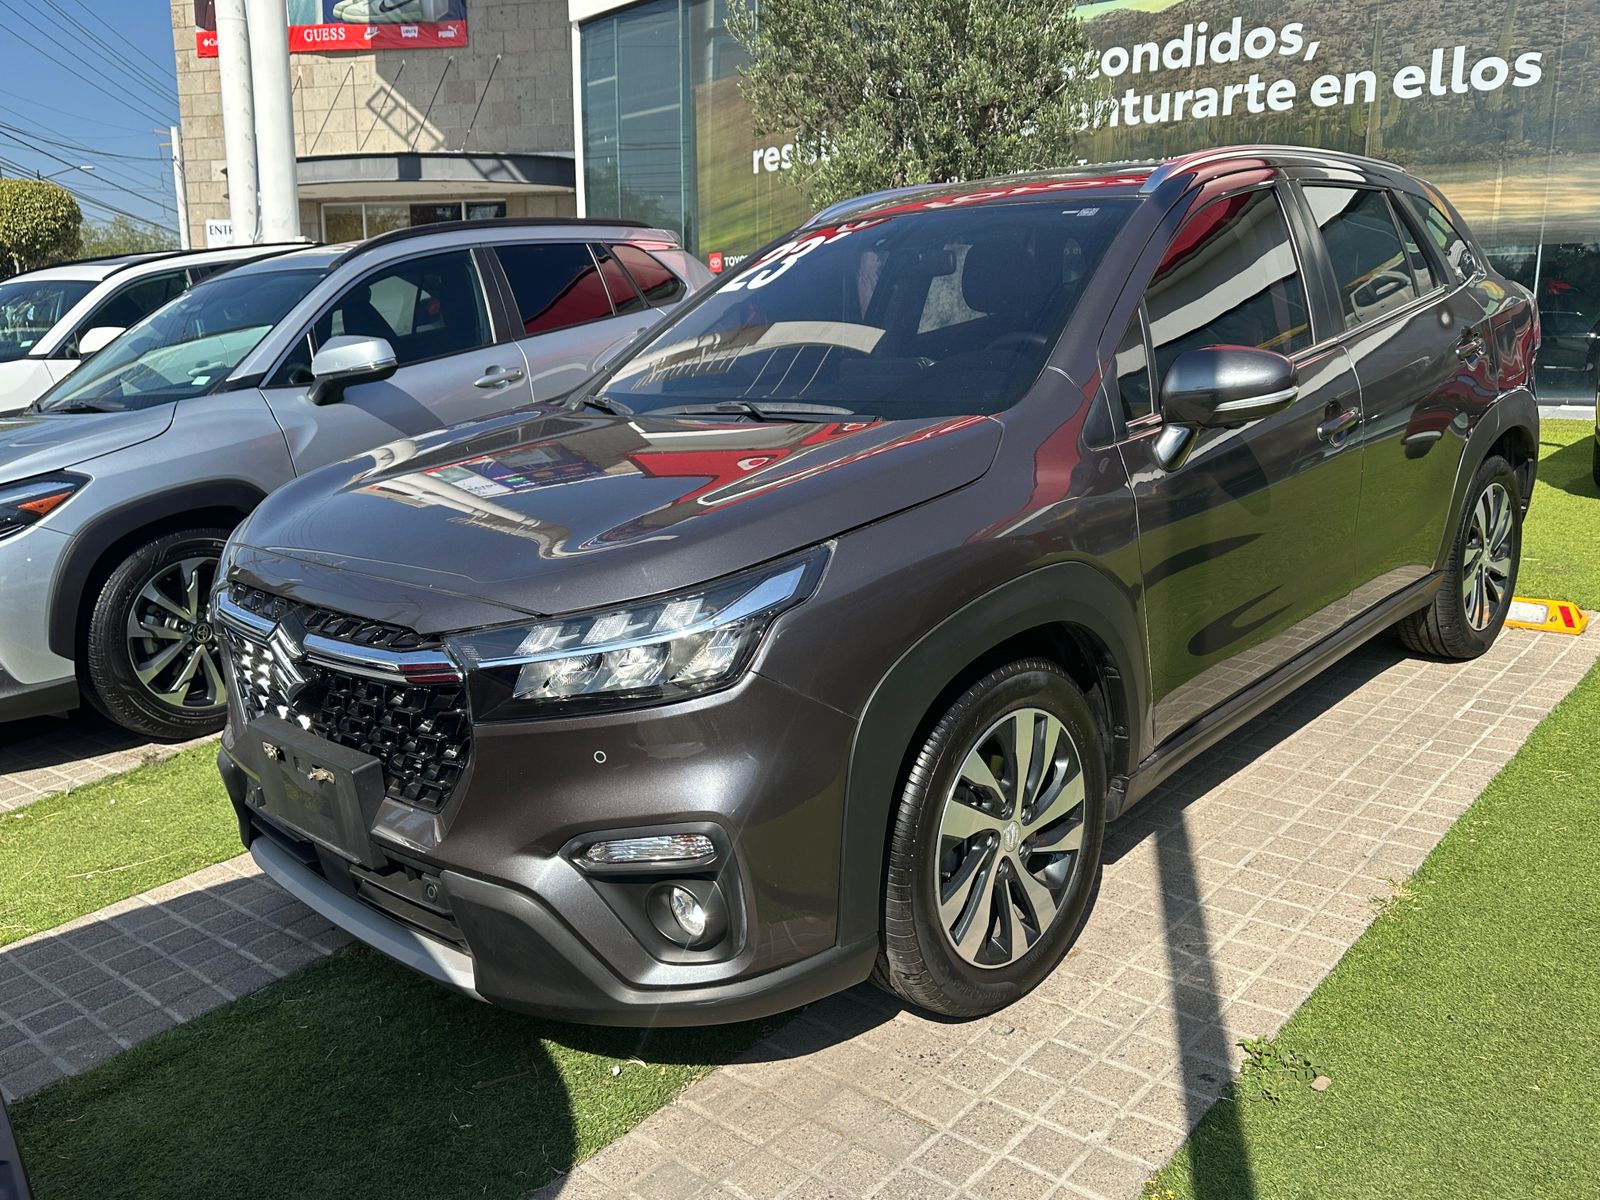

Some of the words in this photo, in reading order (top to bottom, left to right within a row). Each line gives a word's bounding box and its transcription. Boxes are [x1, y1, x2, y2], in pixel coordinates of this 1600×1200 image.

[303, 27, 346, 42] GUESS
[1310, 70, 1377, 108] en
[1392, 45, 1544, 99] ellos
